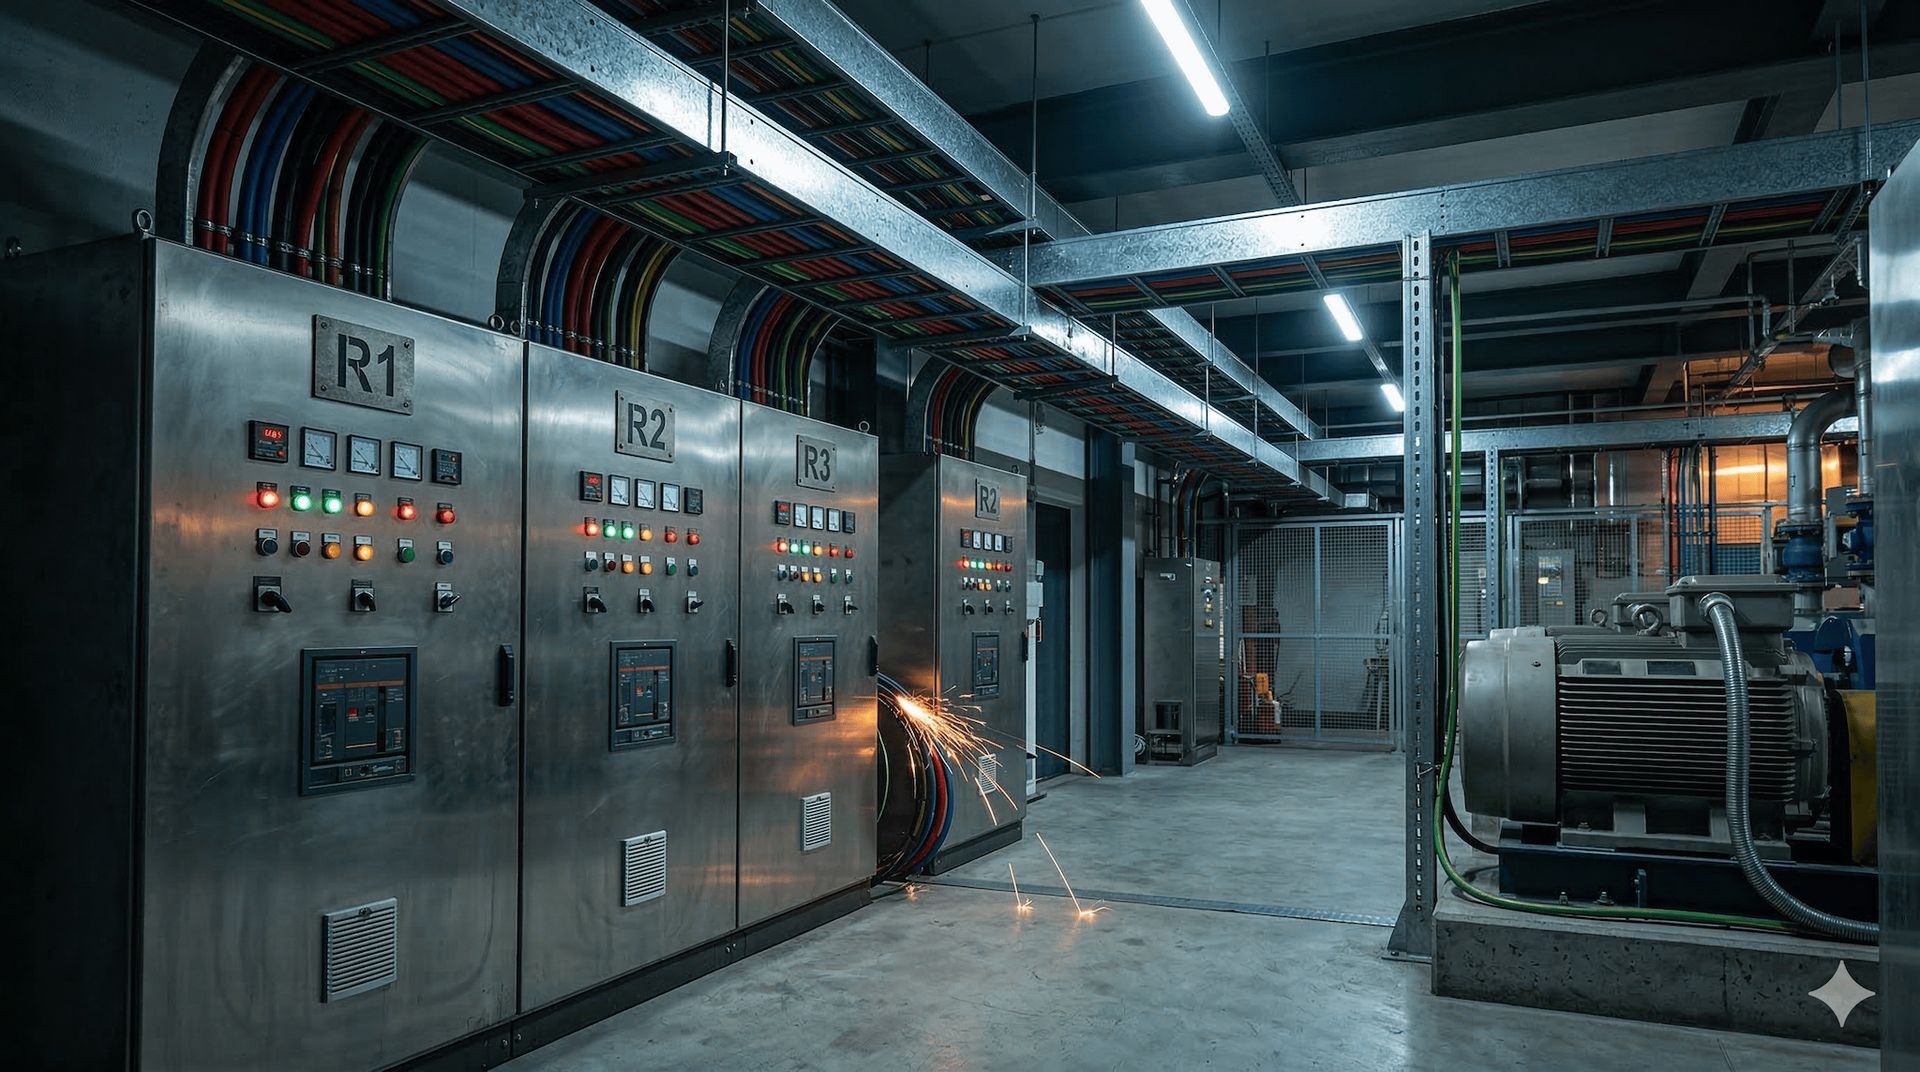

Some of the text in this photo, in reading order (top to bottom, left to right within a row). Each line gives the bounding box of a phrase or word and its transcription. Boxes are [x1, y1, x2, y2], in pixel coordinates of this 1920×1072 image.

[337, 333, 394, 397] R1
[627, 402, 666, 451] R2
[804, 444, 830, 482] R3
[980, 485, 998, 514] R2
